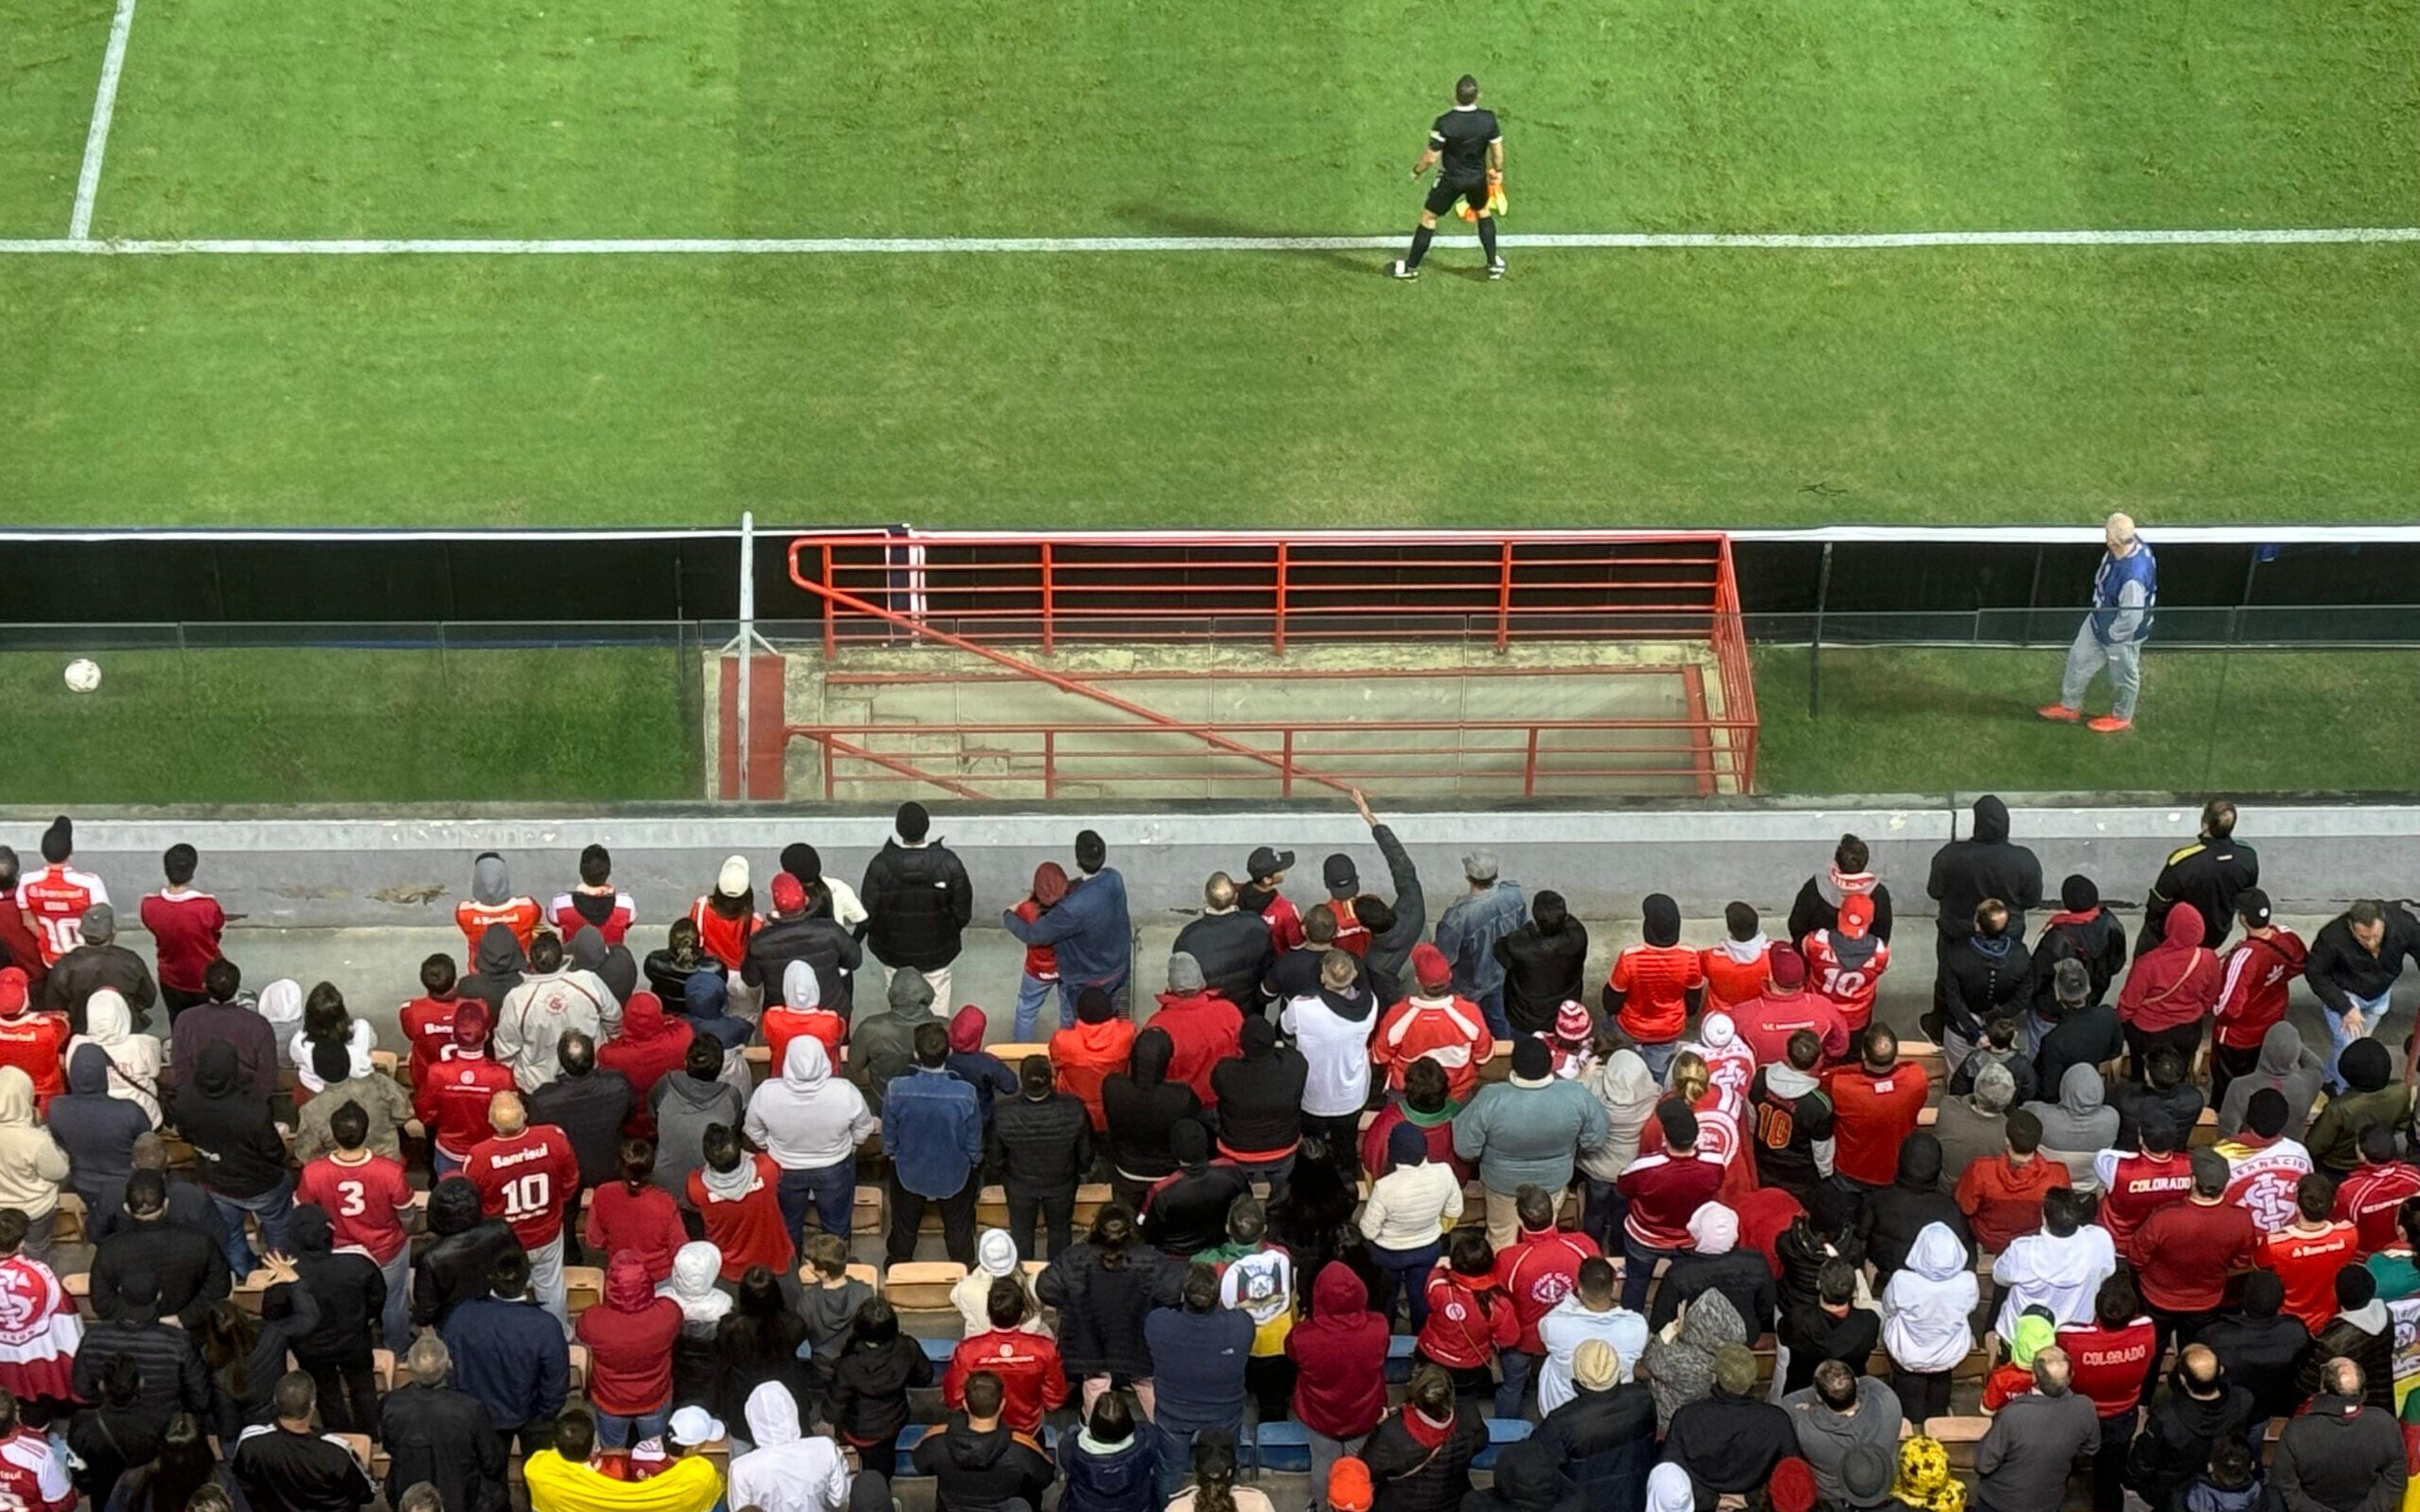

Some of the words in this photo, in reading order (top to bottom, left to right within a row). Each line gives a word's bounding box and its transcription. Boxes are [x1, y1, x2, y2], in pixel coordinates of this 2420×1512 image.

[1821, 968, 1866, 998] 10
[1758, 1102, 1793, 1150] 10
[490, 1142, 548, 1169] Banrisul
[337, 1180, 366, 1217] 3
[501, 1172, 550, 1215] 10
[2128, 1176, 2192, 1194] COLORADO
[2082, 1343, 2146, 1366] COLORADO
